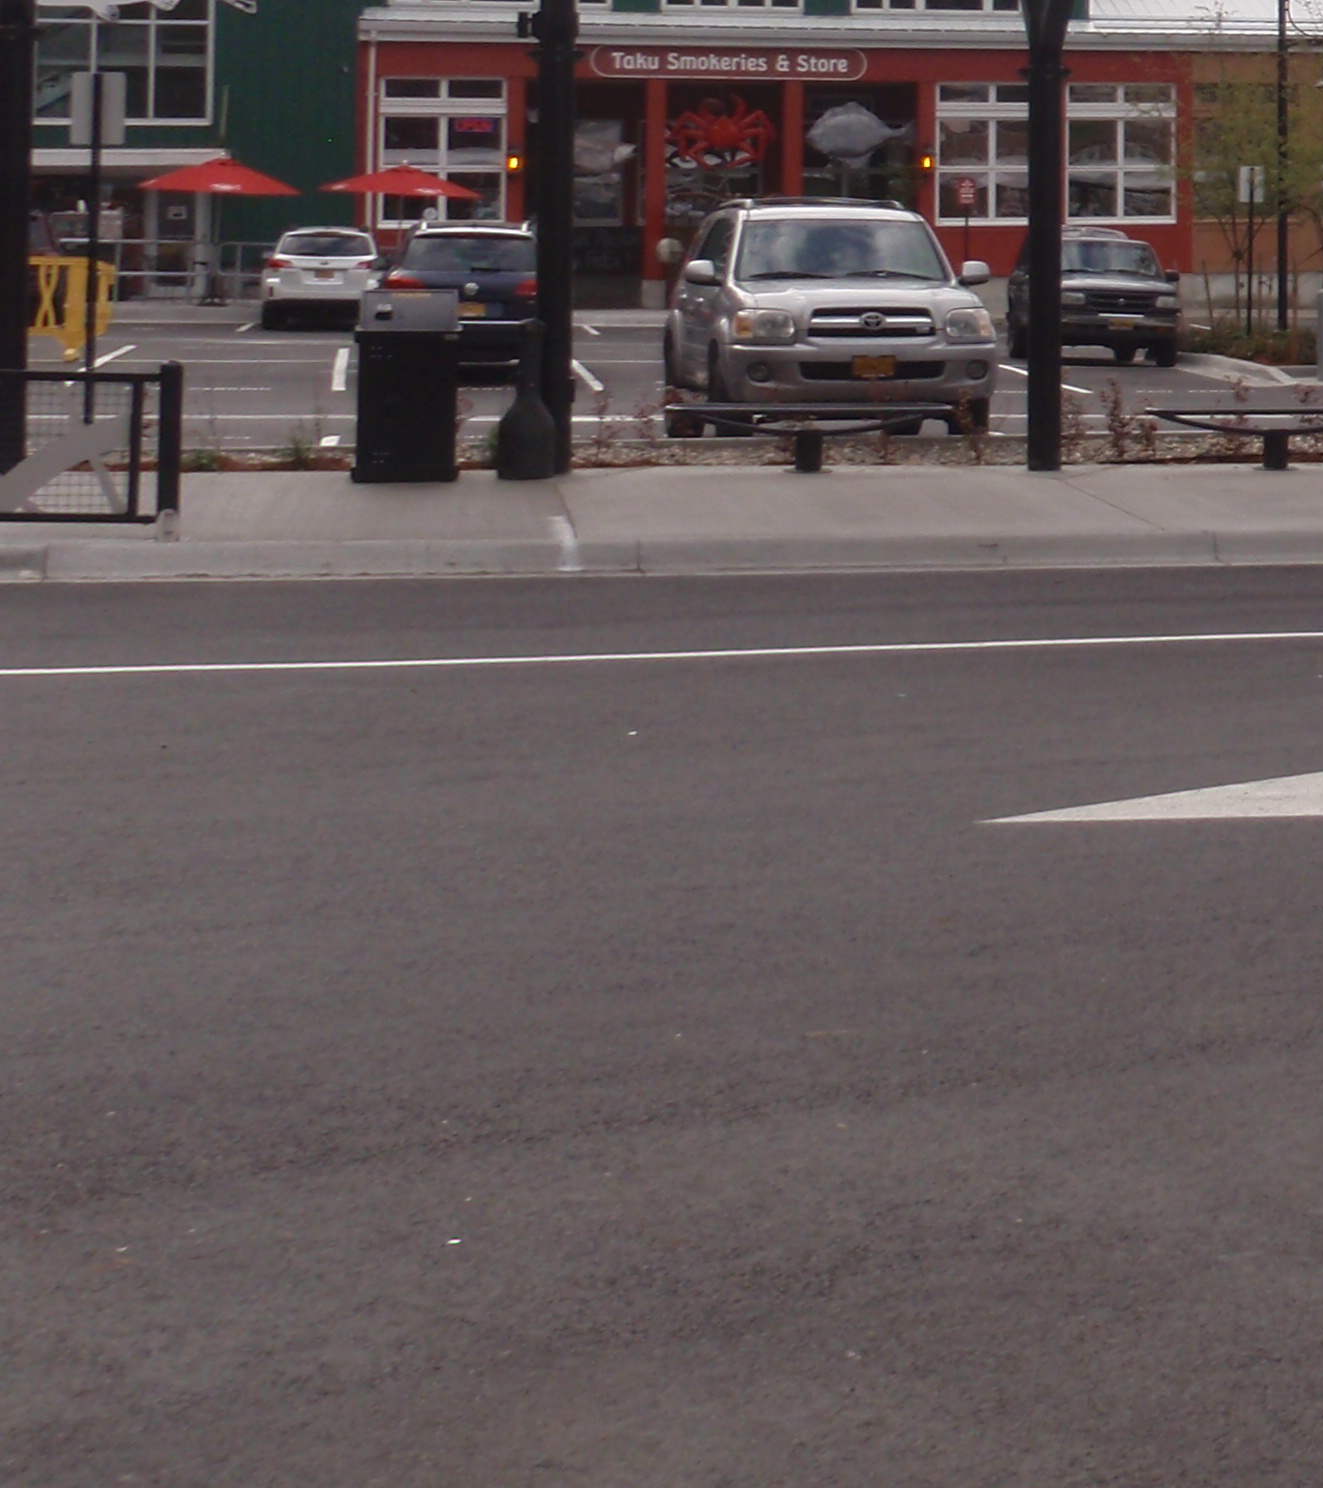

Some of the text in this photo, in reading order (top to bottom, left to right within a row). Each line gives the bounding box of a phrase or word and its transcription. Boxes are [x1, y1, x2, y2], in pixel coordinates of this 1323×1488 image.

[611, 51, 849, 73] Taku Smokeries & Store
